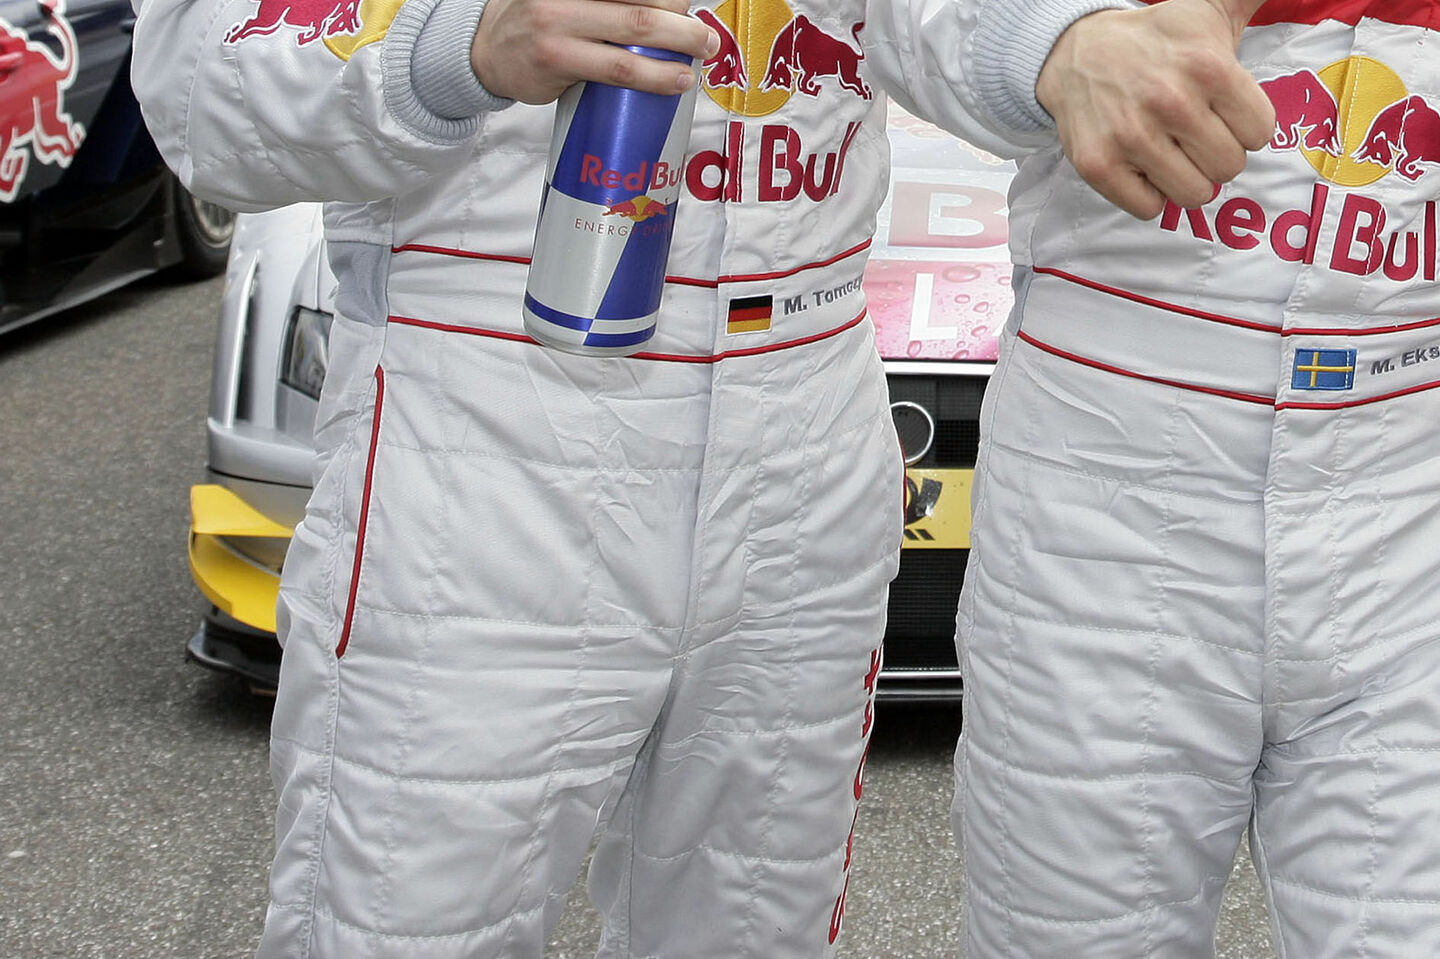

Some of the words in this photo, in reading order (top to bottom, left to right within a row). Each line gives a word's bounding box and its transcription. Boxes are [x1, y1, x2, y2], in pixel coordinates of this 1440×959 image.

[579, 153, 649, 192] Red
[649, 153, 687, 191] Bul
[783, 294, 808, 316] M.
[908, 273, 958, 340] L
[1369, 356, 1397, 376] M.
